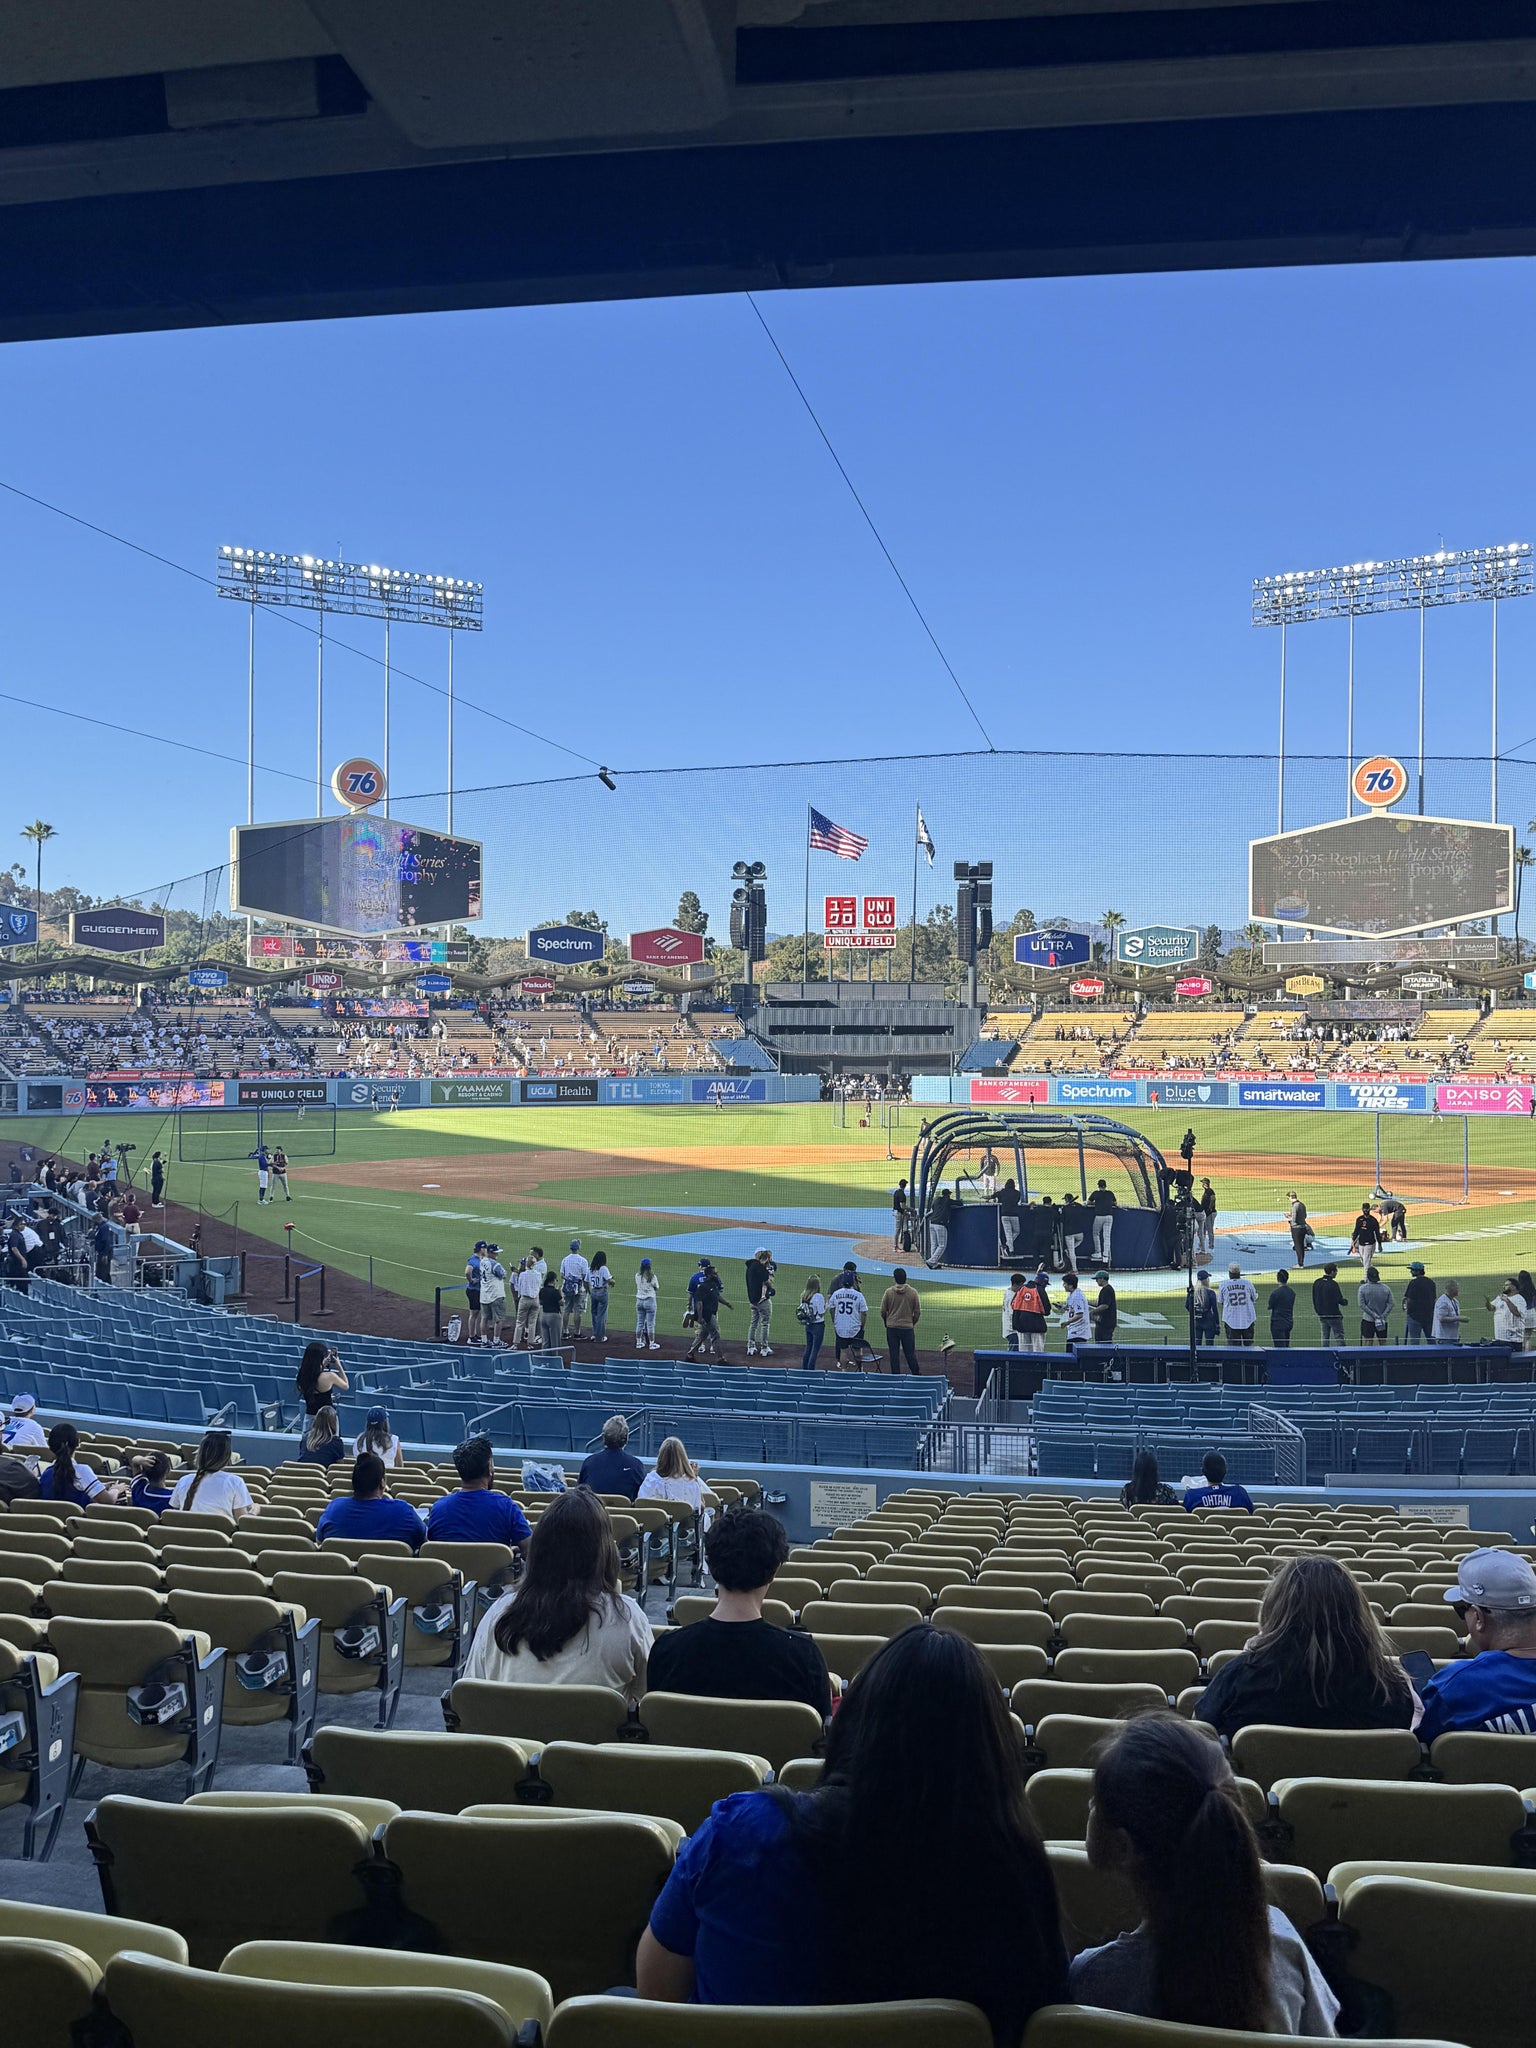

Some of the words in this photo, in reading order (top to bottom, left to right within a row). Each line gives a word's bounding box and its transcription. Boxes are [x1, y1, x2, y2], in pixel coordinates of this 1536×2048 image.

[347, 772, 377, 794] 76
[1364, 768, 1395, 793] 76
[412, 853, 445, 868] Series
[1292, 853, 1324, 867] 2025
[1330, 852, 1381, 868] Replica
[1408, 862, 1457, 880] Trophy
[829, 900, 853, 911] ユニ
[867, 901, 890, 912] UNI
[829, 913, 853, 924] クロ
[867, 914, 892, 926] QLO
[81, 924, 159, 936] GUGGENHEIM
[537, 938, 593, 951] Spectrum
[828, 937, 862, 946] UNIQLO
[864, 937, 892, 946] FIELD
[1031, 940, 1074, 951] ULTRA
[1148, 935, 1191, 947] Security
[1148, 947, 1185, 957] Benefit
[312, 975, 338, 986] JINRO
[523, 981, 553, 989] Yakult
[1071, 982, 1103, 993] Churu
[371, 1083, 407, 1094] Security
[531, 1087, 553, 1096] UCLA
[559, 1086, 592, 1096] Health
[608, 1083, 643, 1098] TEL
[706, 1081, 735, 1093] ANA
[1062, 1084, 1126, 1098] Spectrum
[1165, 1086, 1196, 1098] blue
[1349, 1085, 1397, 1097] TOYO
[65, 1092, 82, 1104] 76
[261, 1090, 295, 1100] UNIQLO
[1243, 1089, 1320, 1101] smartwater
[1446, 1089, 1502, 1100] DAISO
[1356, 1096, 1410, 1108] TIRES
[590, 1276, 600, 1288] 50
[1229, 1292, 1247, 1306] 22
[838, 1301, 853, 1315] 35
[1201, 1494, 1232, 1507] OHTANI
